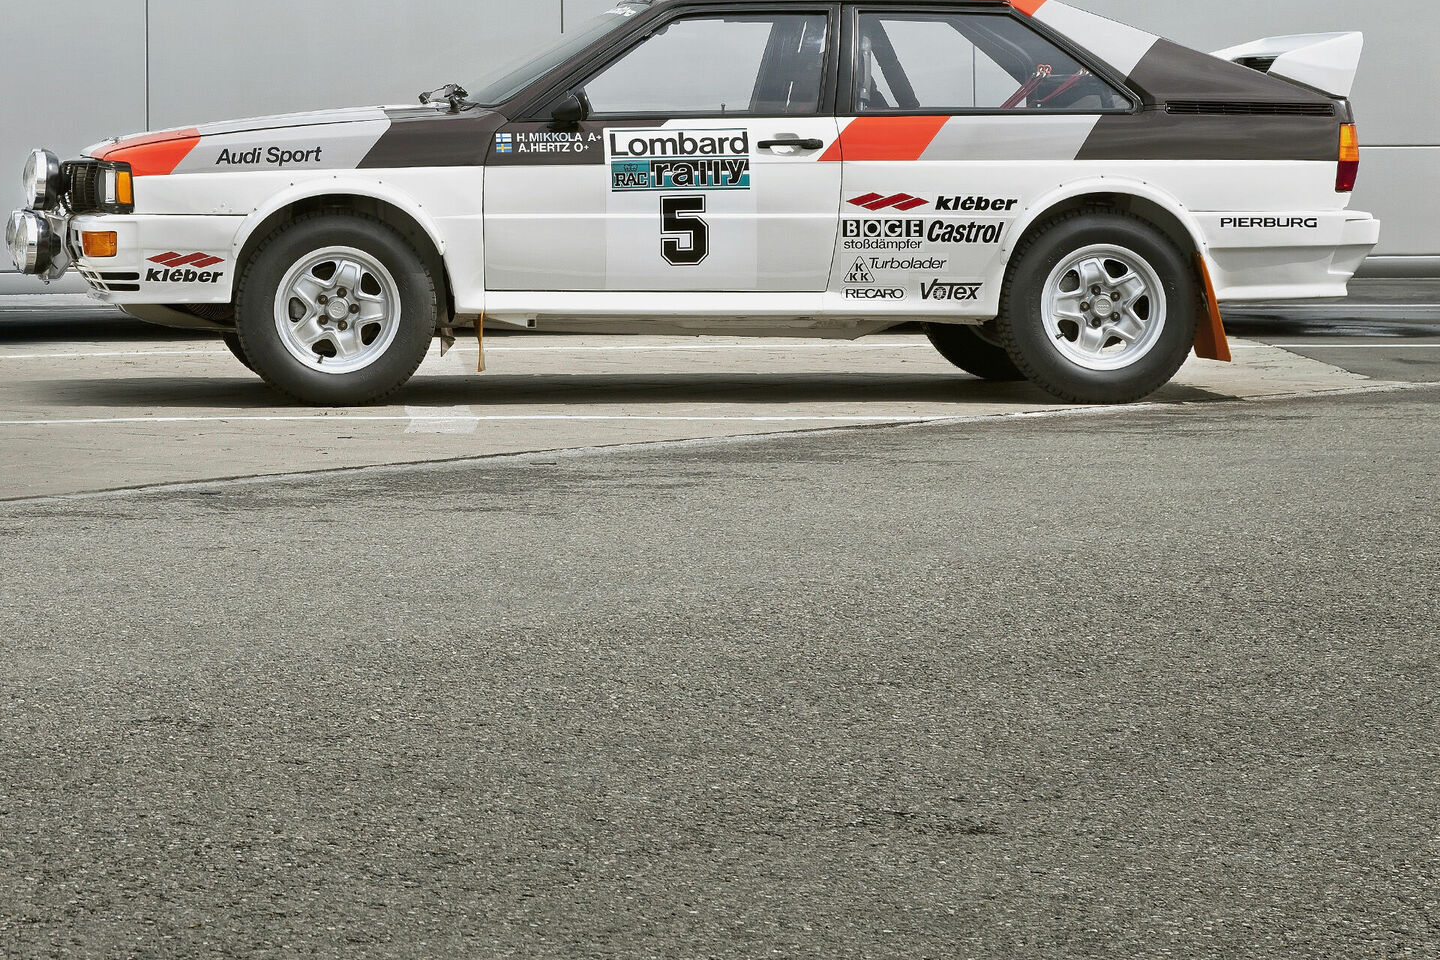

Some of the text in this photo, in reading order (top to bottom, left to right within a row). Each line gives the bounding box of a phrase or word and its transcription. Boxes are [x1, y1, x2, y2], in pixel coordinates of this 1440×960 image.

[516, 132, 582, 142] H.MIKKOLA
[610, 131, 748, 157] Lombard
[518, 142, 570, 153] A.HERTZ
[215, 146, 323, 167] Audi Sport
[614, 159, 747, 188] RAC rally
[935, 195, 1018, 211] kléber
[659, 194, 710, 266] 5
[843, 219, 924, 237] BOGE
[1220, 217, 1318, 228] PIERBURG
[926, 219, 1005, 244] Castrol
[843, 238, 923, 250] stoßdämpfer
[869, 256, 947, 270] Turbolader
[145, 267, 224, 283] kléber
[845, 288, 904, 299] RECARO
